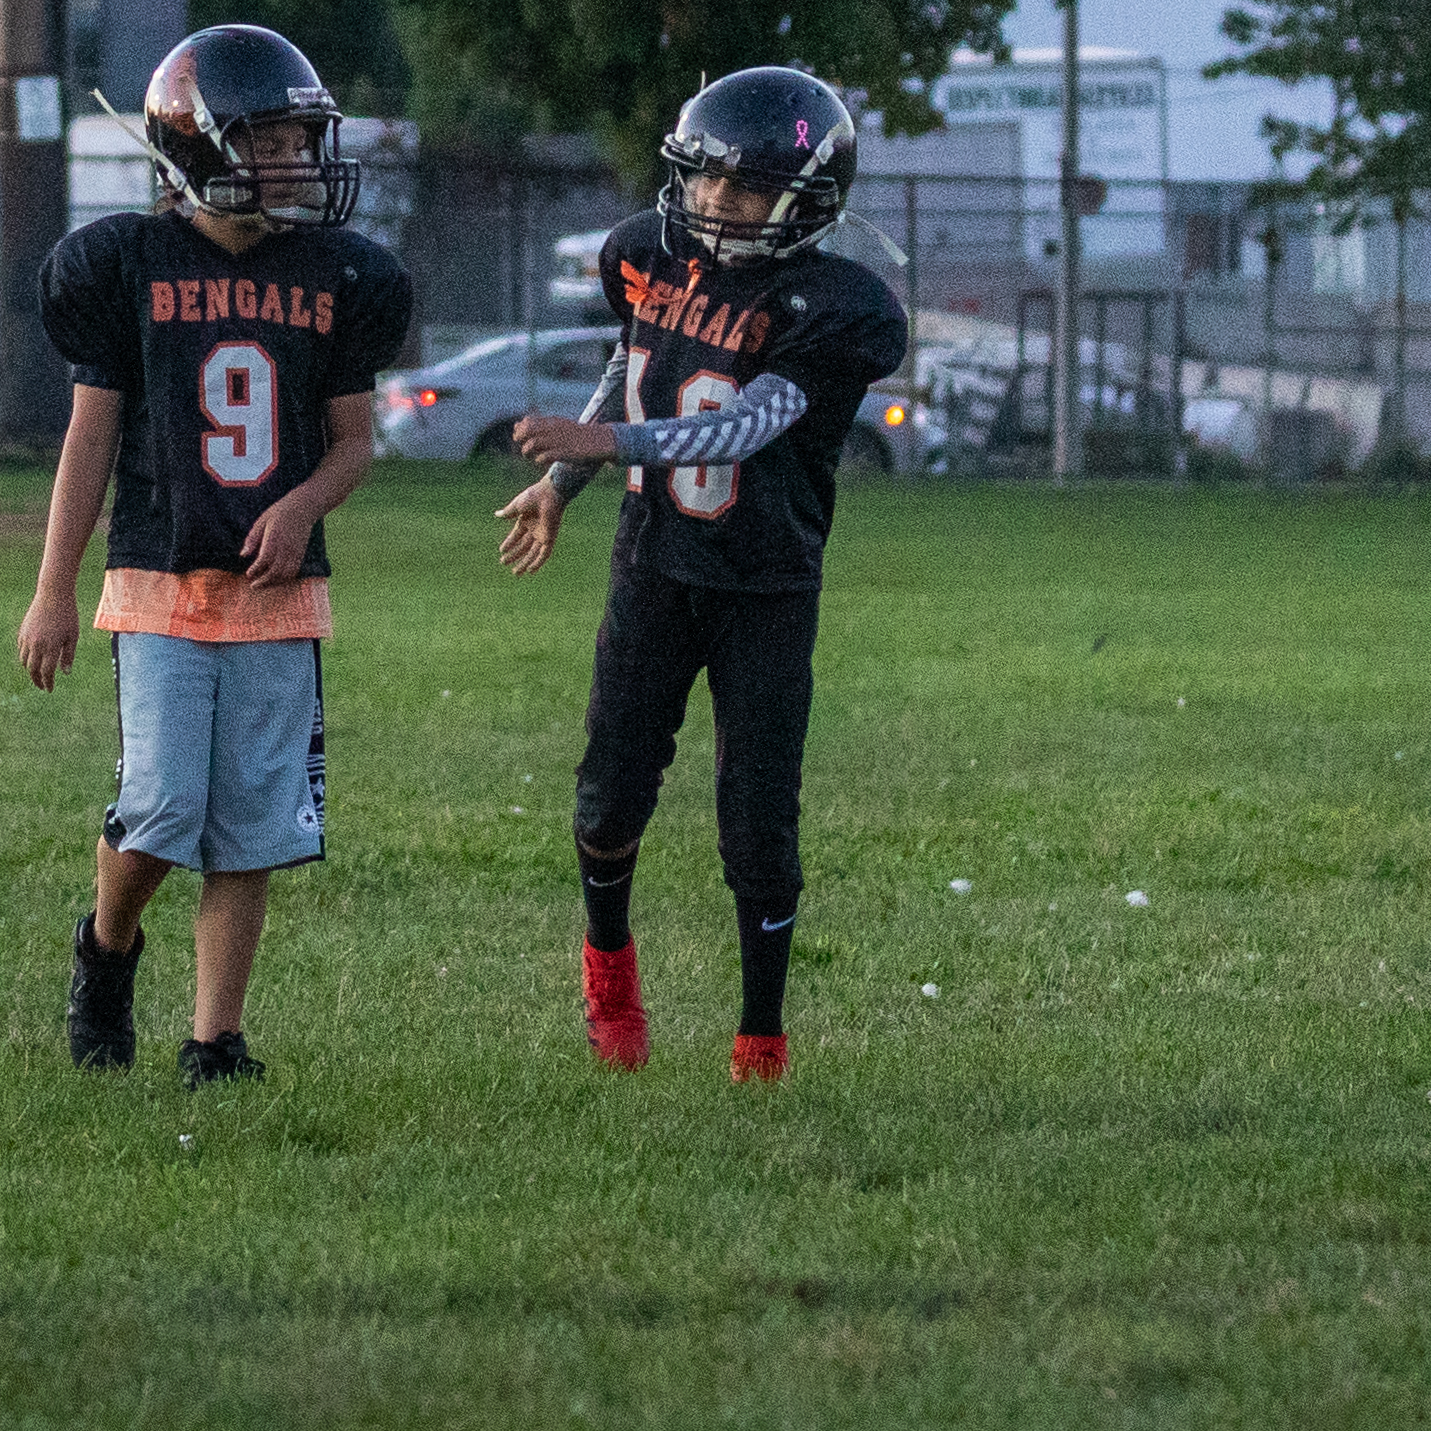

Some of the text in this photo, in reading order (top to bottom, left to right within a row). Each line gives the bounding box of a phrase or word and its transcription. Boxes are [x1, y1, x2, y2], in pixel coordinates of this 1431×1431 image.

[150, 278, 334, 335] BENGALS
[635, 272, 771, 354] ENGALS
[198, 341, 279, 488] 9
